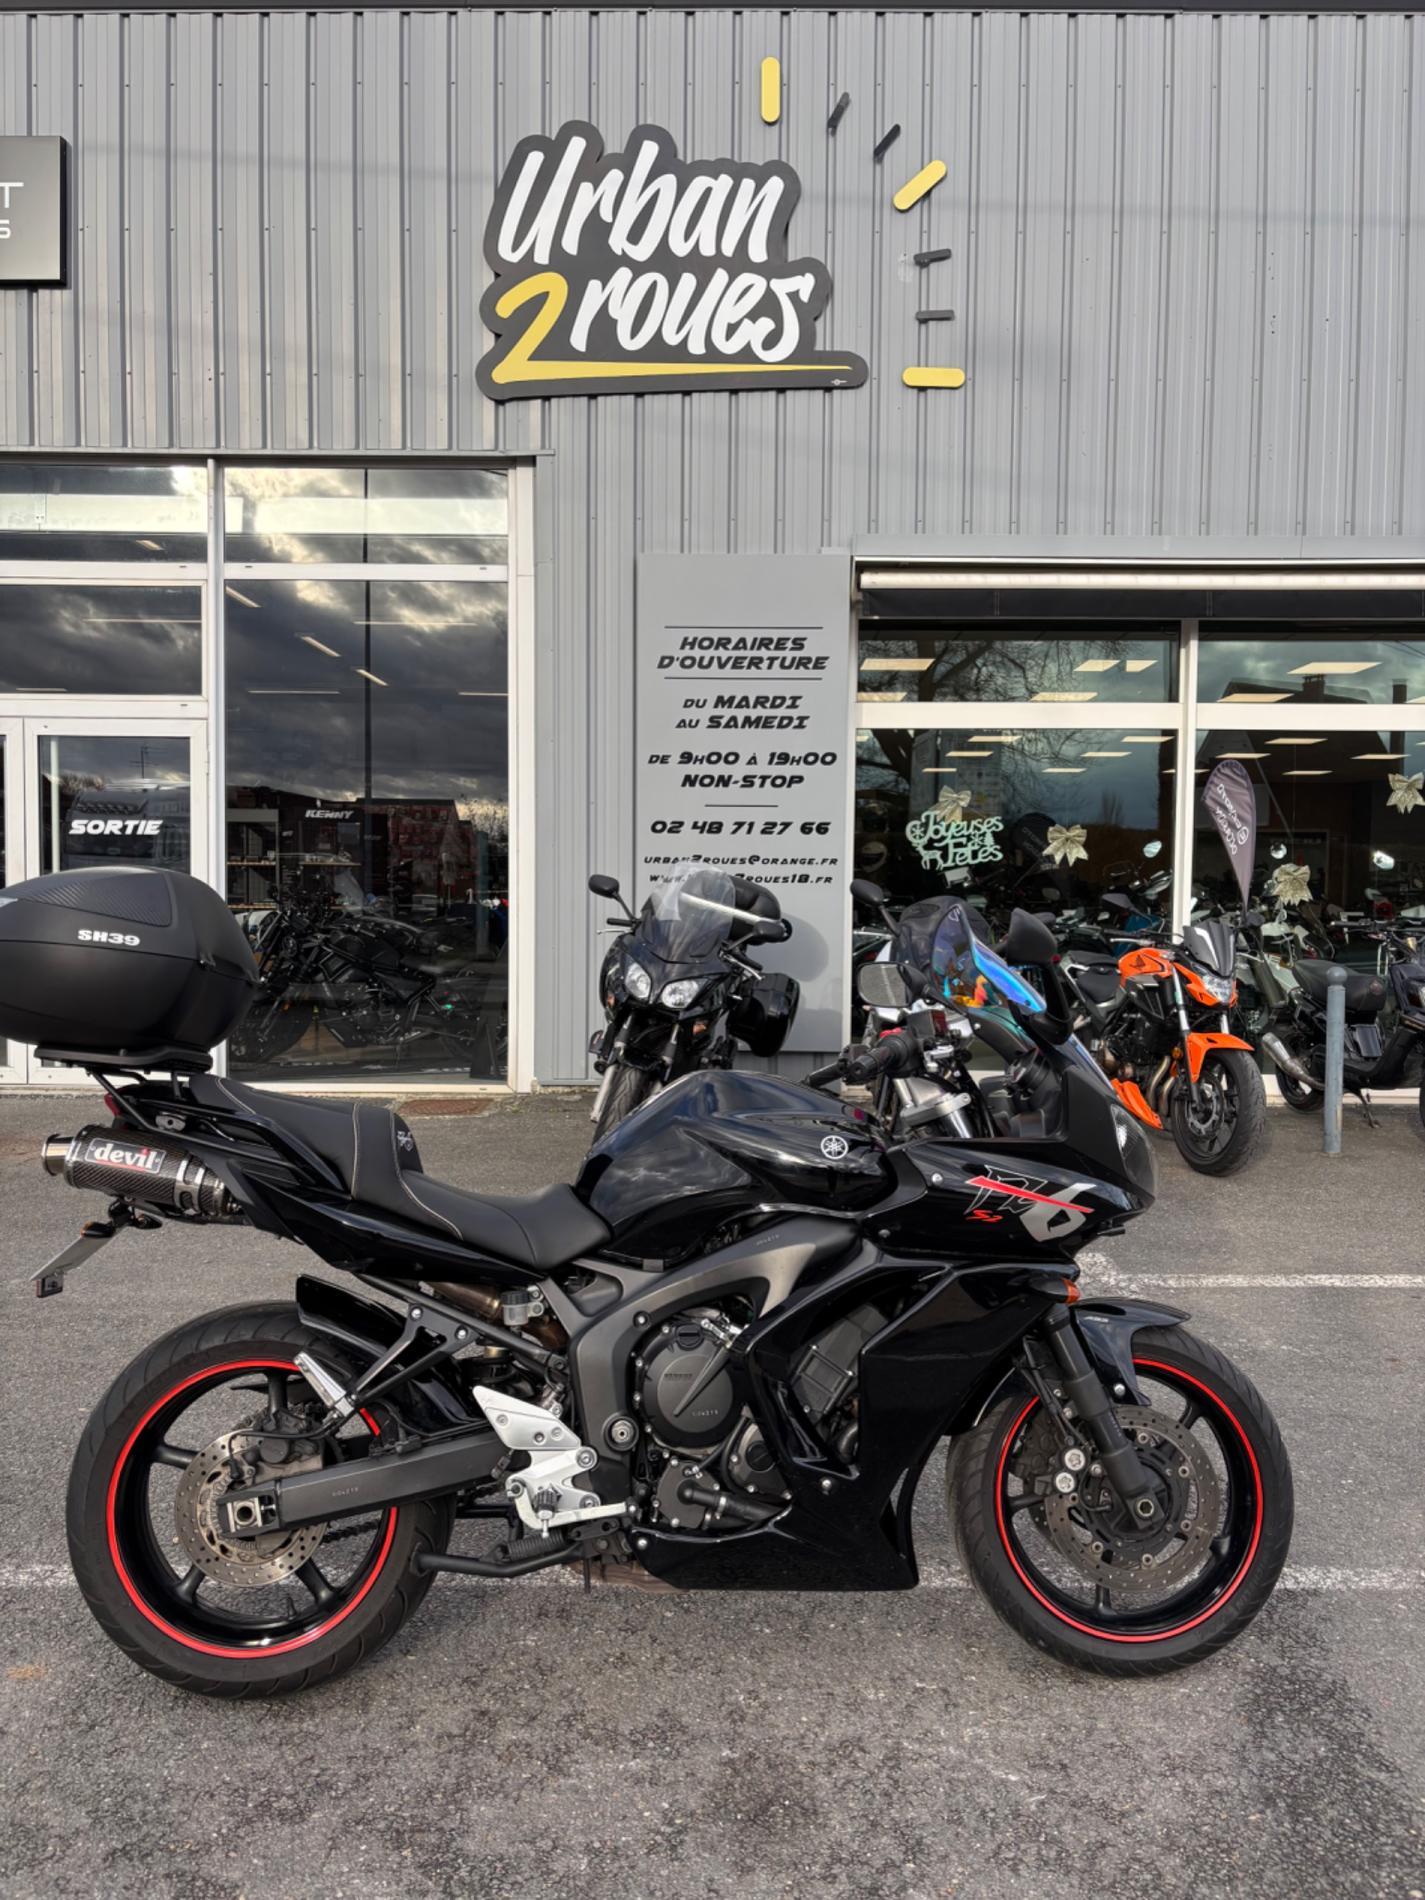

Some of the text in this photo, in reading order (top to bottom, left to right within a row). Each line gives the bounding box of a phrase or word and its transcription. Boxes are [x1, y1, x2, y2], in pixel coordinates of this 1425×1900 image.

[498, 136, 785, 264] Urban
[569, 266, 816, 363] roues
[679, 636, 808, 651] HORAIRES
[656, 655, 830, 670] D'OUVERTURE
[682, 695, 803, 709] DU MARDI
[675, 715, 811, 729] AU SAMEDI
[648, 754, 672, 765] DE
[681, 774, 805, 789] NON-STOP
[68, 819, 164, 836] SORTIE
[650, 820, 831, 835] 02 48 71 27 66
[77, 929, 141, 946] SH39
[94, 1143, 157, 1169] devil
